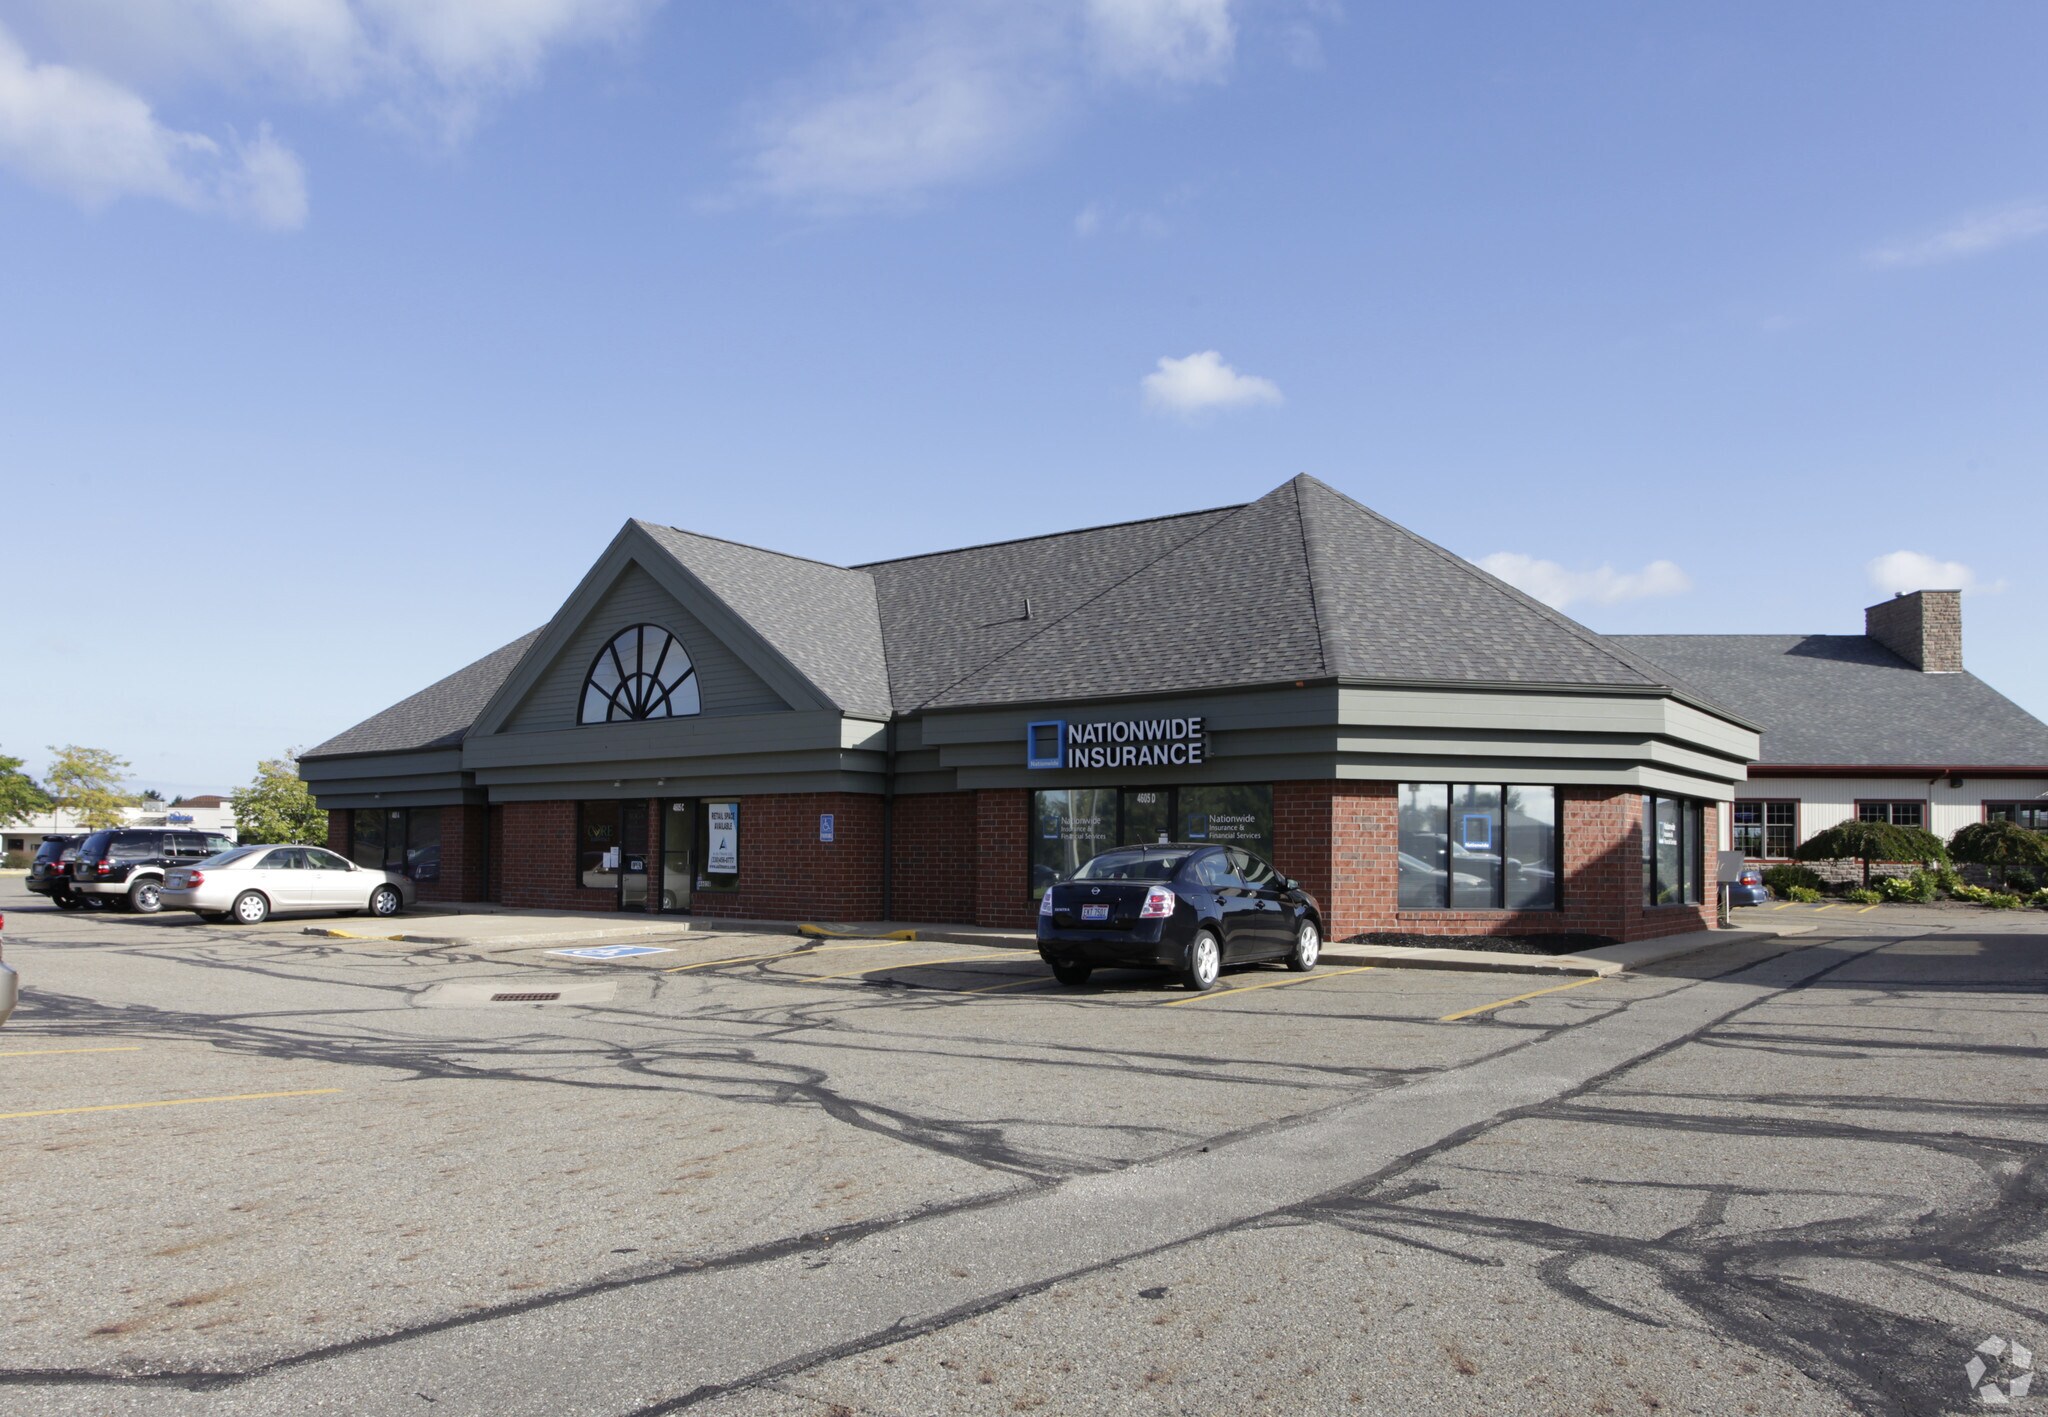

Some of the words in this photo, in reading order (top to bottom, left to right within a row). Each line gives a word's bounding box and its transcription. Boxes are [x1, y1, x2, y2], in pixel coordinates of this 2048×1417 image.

[1068, 717, 1202, 744] NATIONWIDE
[1068, 742, 1203, 769] INSURANCE
[1137, 793, 1151, 803] 4605
[712, 812, 723, 820] RETAIL
[1061, 816, 1101, 825] Nationwide
[1209, 814, 1256, 823] Nationwide
[714, 822, 732, 831] AVAILABLE
